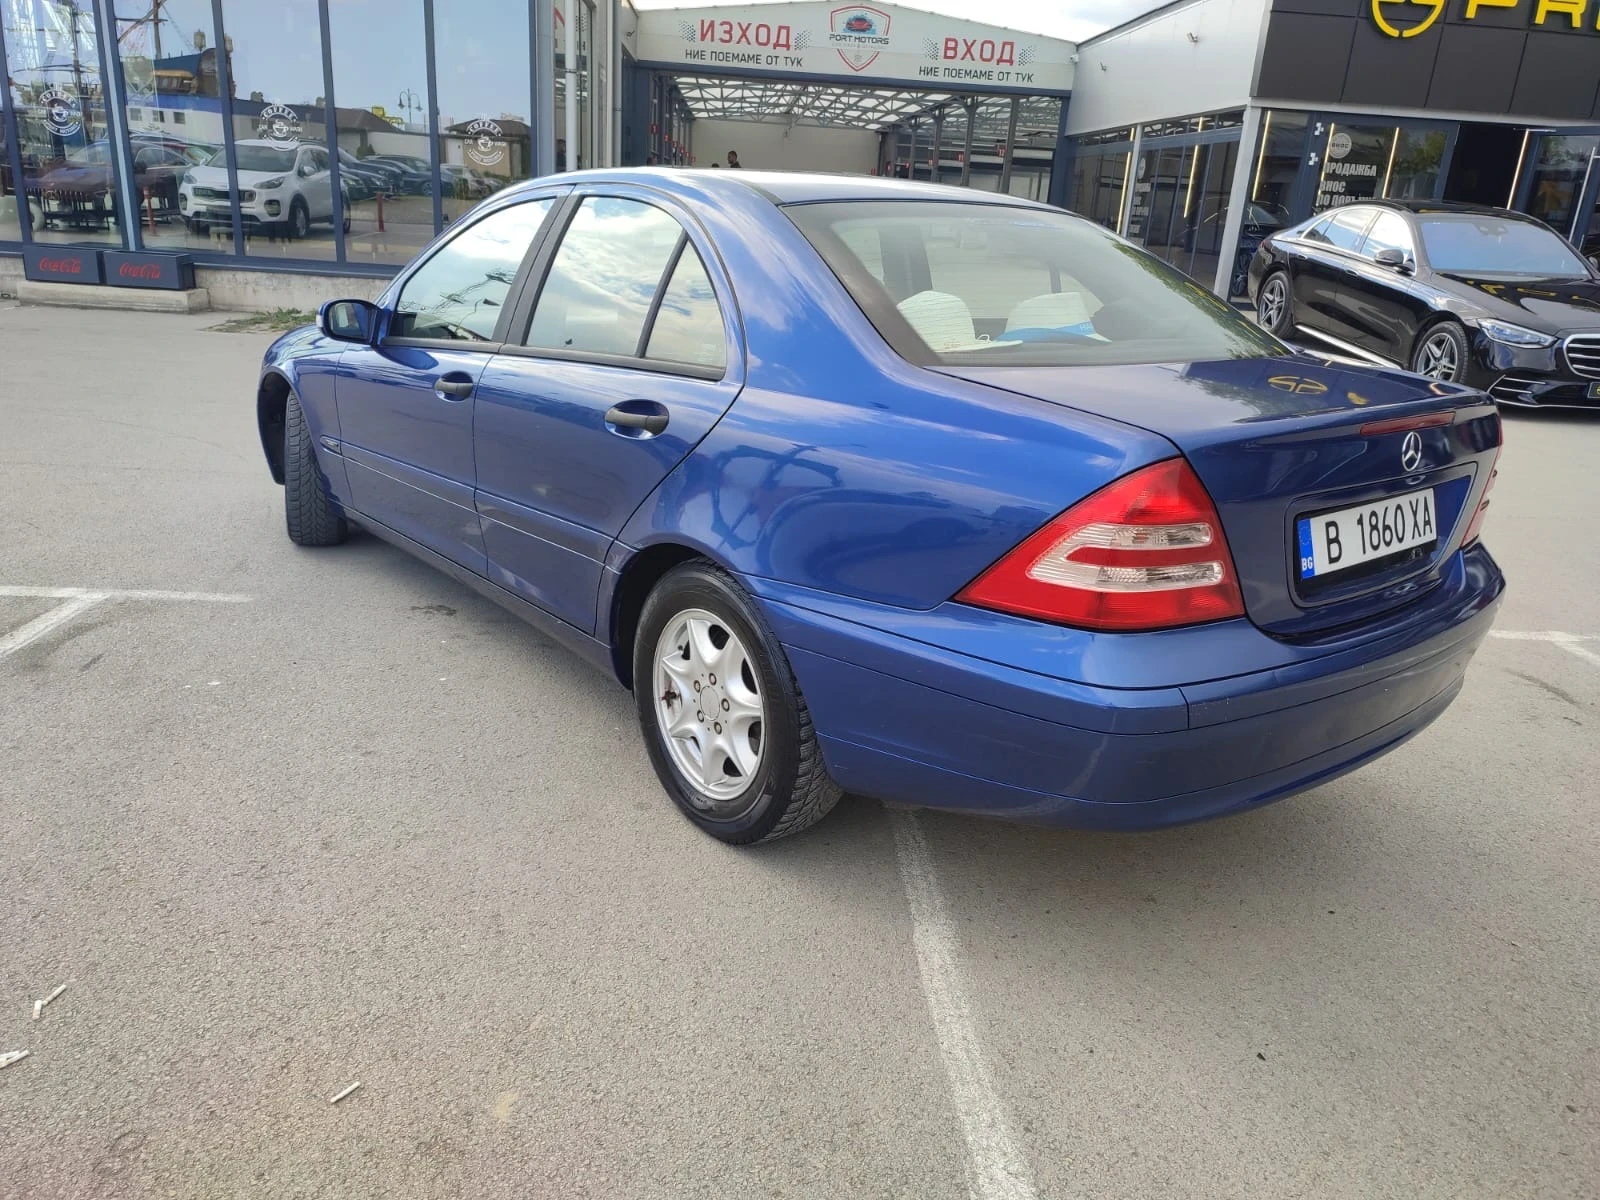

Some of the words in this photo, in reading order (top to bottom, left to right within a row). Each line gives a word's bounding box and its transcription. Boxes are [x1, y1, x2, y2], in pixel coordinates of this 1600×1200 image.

[700, 19, 791, 51] ИЗХОД
[829, 34, 852, 42] PORT
[854, 36, 890, 45] MOTORS
[685, 49, 706, 60] НИЕ
[710, 51, 762, 64] ПОЕМАМЕ
[766, 55, 779, 65] ОТ
[783, 56, 803, 67] ТУК
[943, 37, 1014, 66] ВХОД
[919, 66, 940, 77] НИЕ
[943, 67, 994, 80] ПОЕМАМЕ
[998, 71, 1012, 81] ОТ
[1015, 72, 1035, 83] ТУК
[1325, 162, 1377, 176] ПРОДАЖБА
[1320, 180, 1346, 193] ВНОС
[1325, 521, 1342, 564] B
[1357, 504, 1405, 555] 1860
[1409, 496, 1433, 540] XA
[1301, 556, 1313, 571] BG
